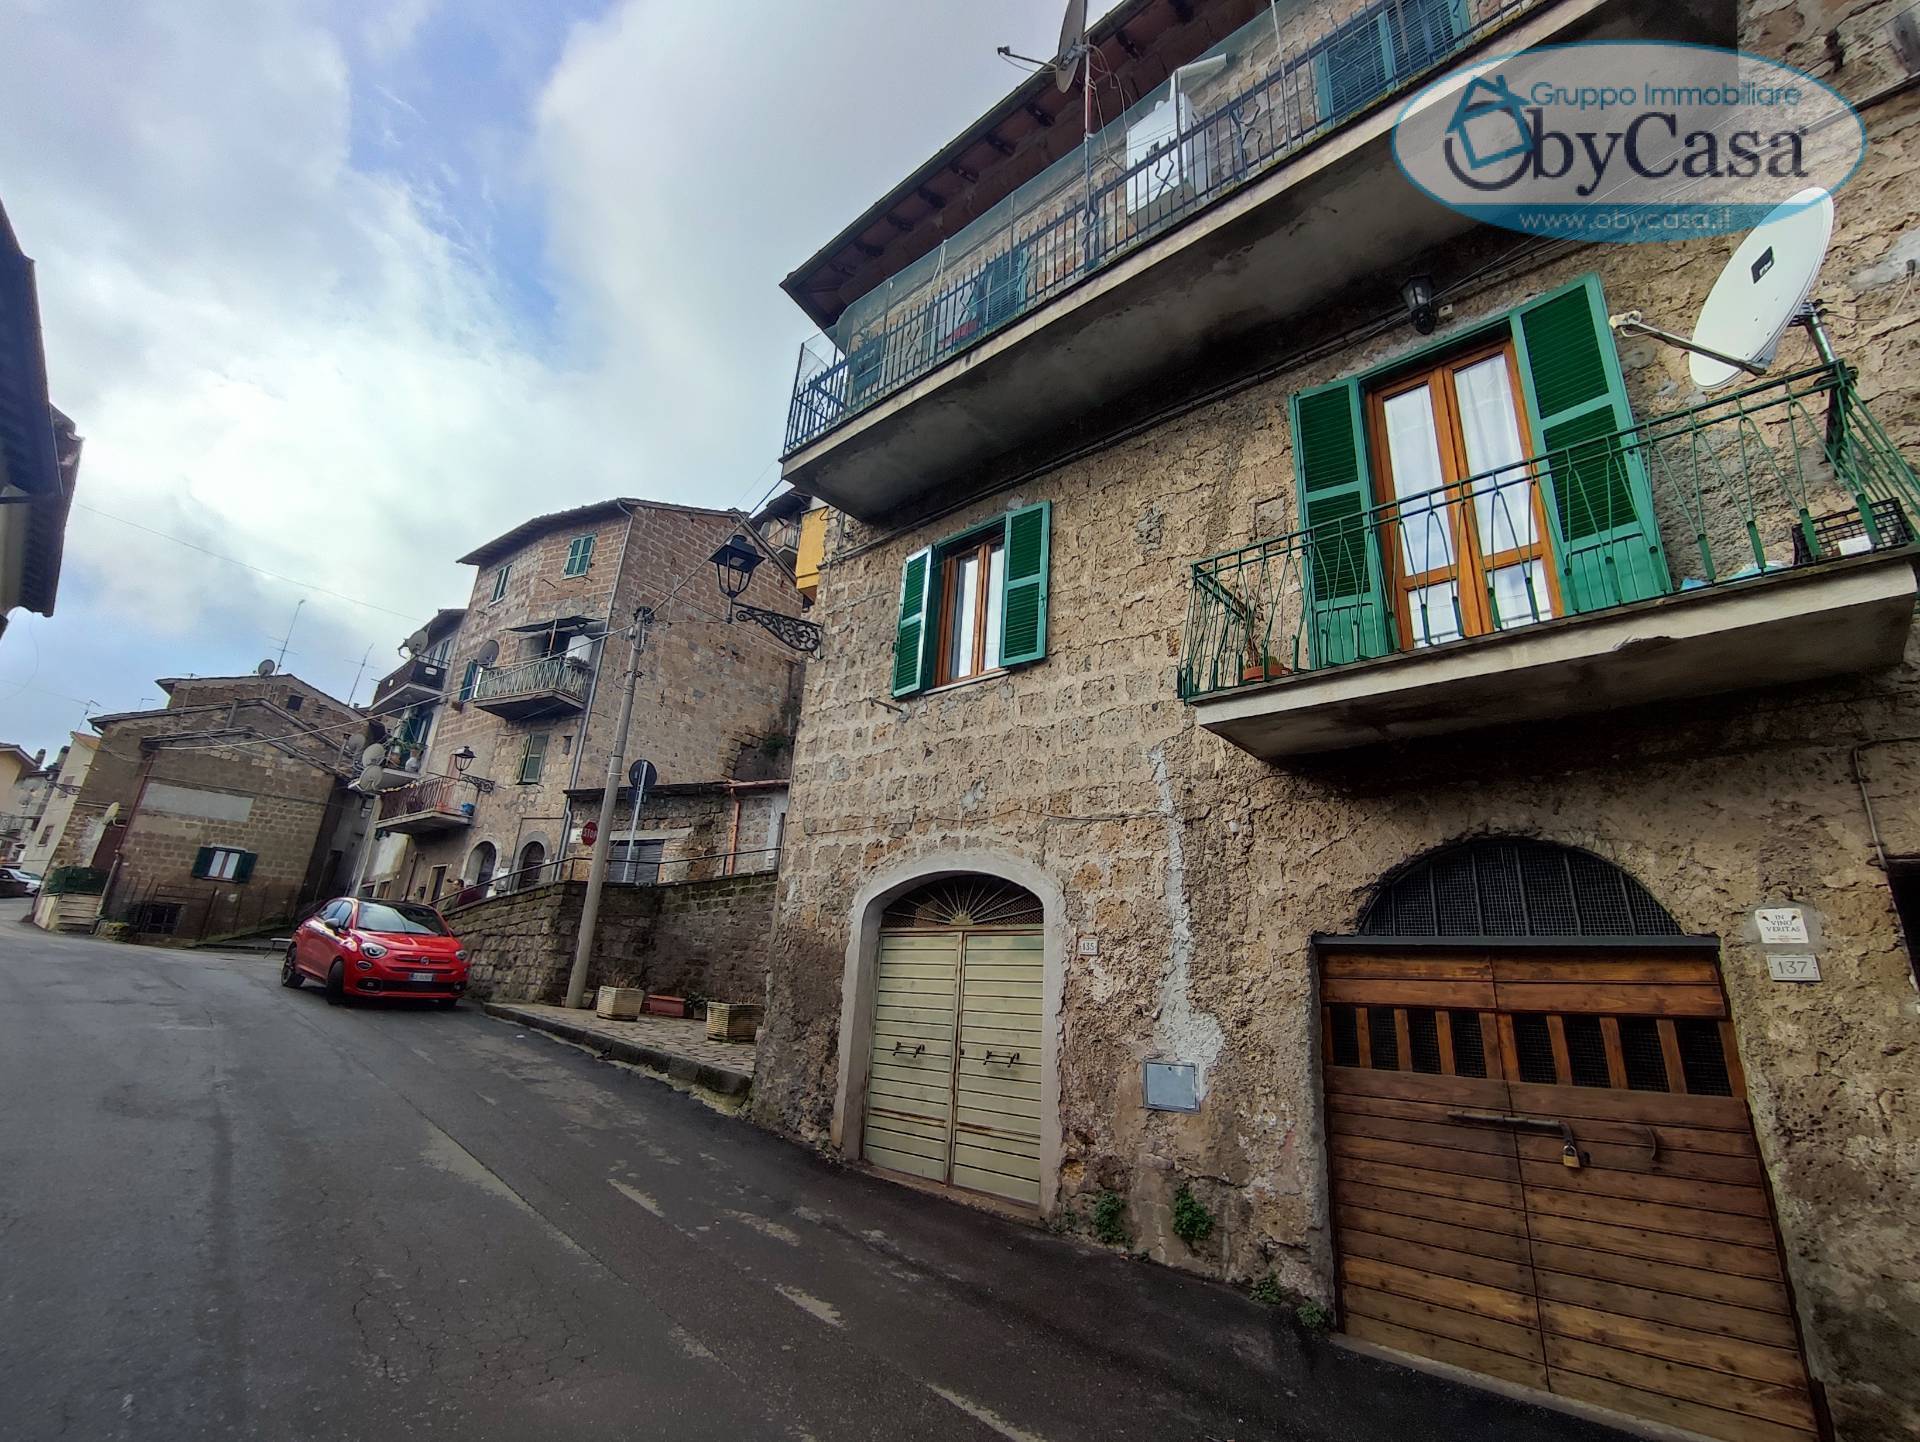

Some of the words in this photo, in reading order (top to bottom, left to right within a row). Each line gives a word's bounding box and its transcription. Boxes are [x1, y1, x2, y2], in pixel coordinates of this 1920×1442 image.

[583, 828, 597, 839] STOP
[1082, 942, 1095, 951] 135
[1778, 960, 1808, 974] 137
